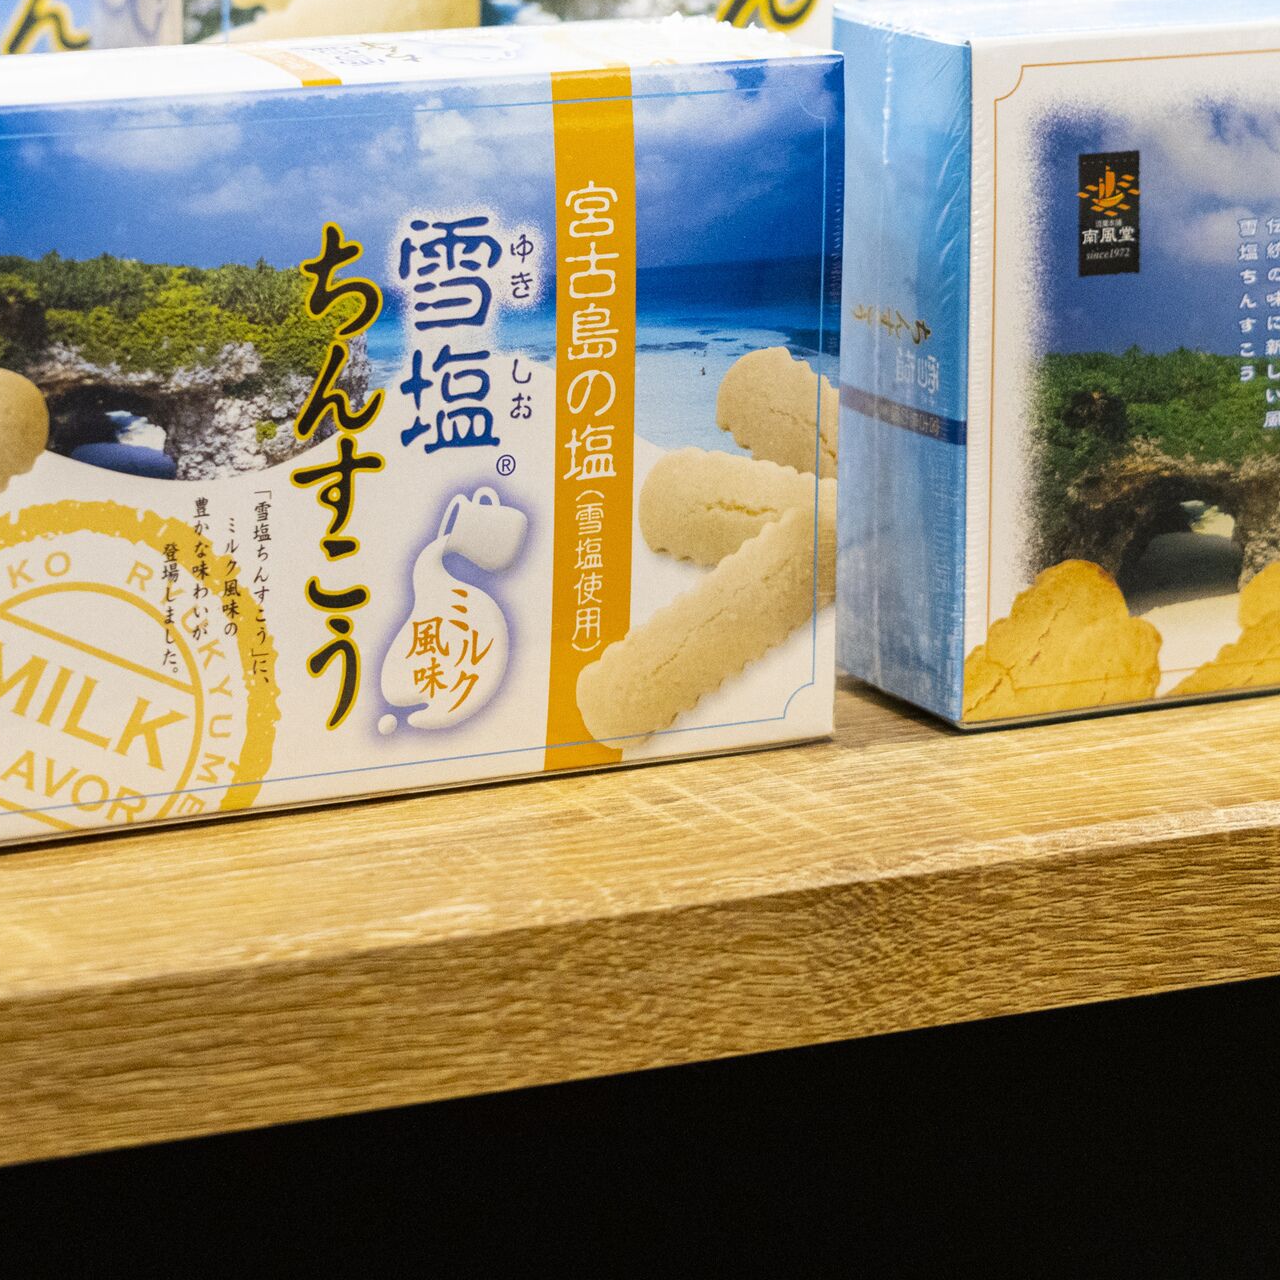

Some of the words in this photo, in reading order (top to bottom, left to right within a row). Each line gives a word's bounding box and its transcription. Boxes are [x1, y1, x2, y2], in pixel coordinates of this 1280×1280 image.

[510, 234, 534, 300] ゆき
[399, 215, 503, 456] 雪塩
[510, 360, 533, 421] しお
[290, 220, 387, 730] ちんすこう
[161, 542, 180, 674] 登場しました。
[192, 496, 211, 641] 豊かな味わいが
[222, 517, 242, 638] ミルク風味の
[405, 616, 451, 698] 風味
[447, 587, 495, 715] ミルク
